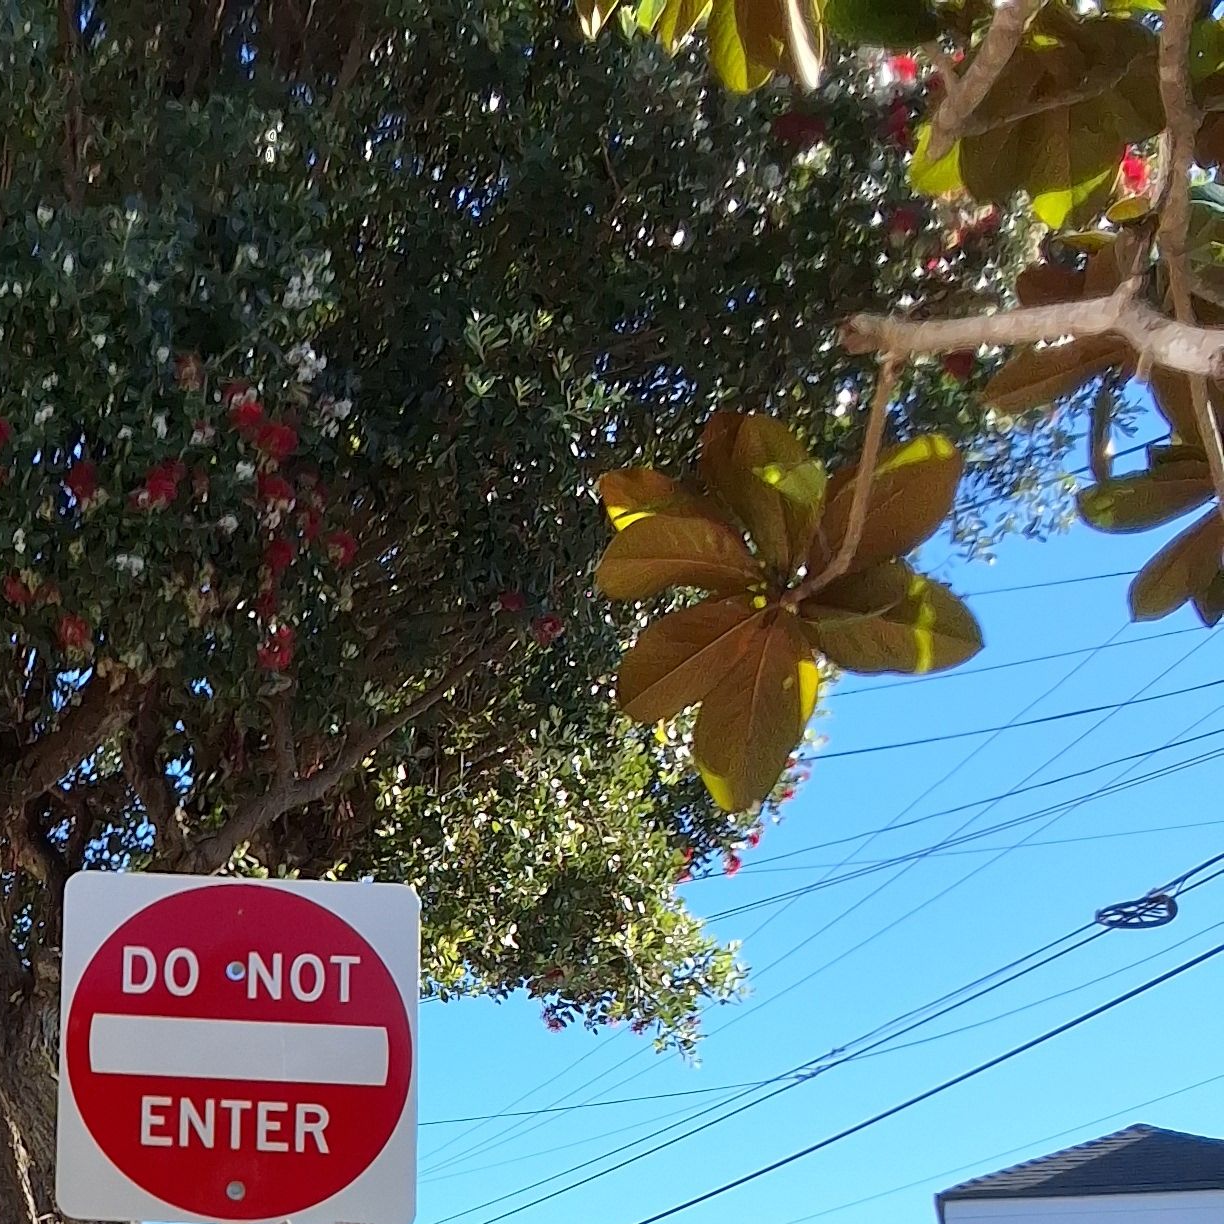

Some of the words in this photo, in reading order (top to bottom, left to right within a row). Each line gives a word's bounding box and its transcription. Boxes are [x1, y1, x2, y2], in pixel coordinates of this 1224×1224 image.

[122, 946, 200, 997] DO
[247, 951, 361, 1003] NOT
[140, 1095, 330, 1154] ENTER
